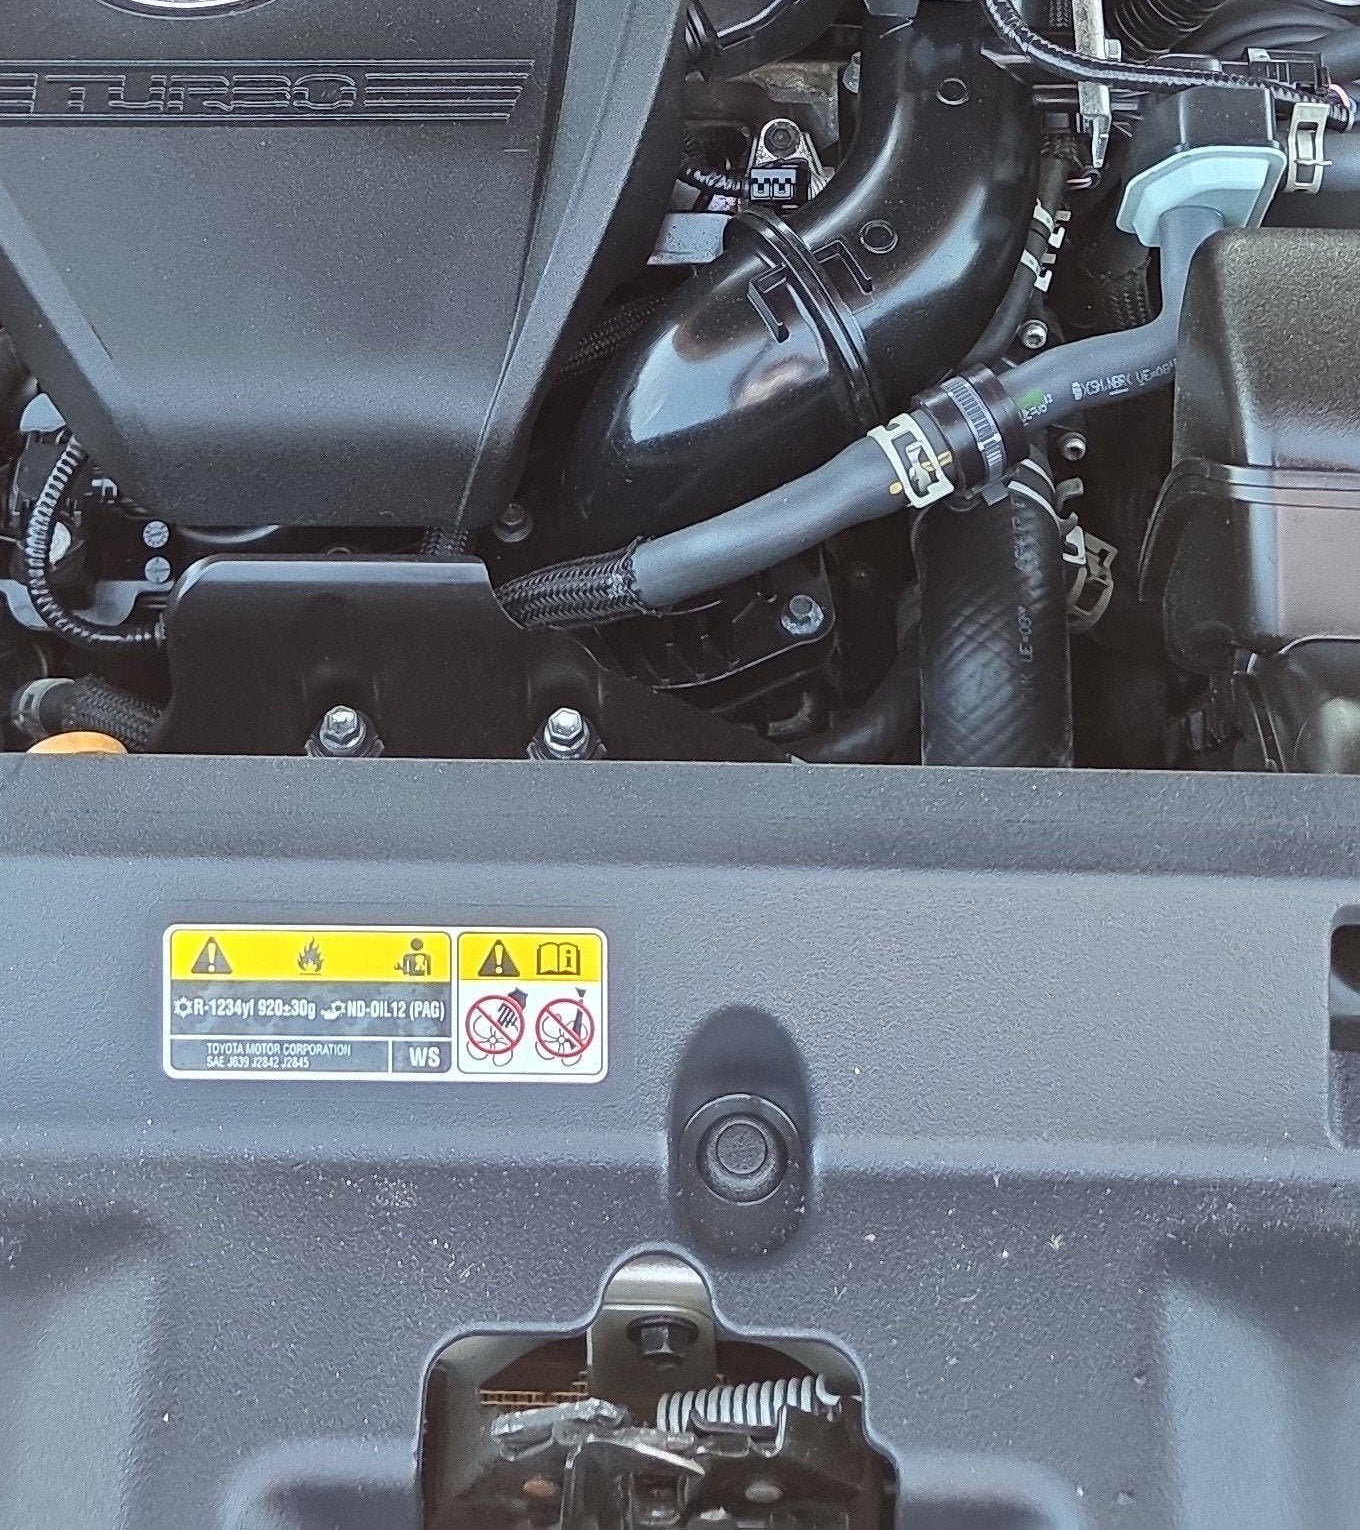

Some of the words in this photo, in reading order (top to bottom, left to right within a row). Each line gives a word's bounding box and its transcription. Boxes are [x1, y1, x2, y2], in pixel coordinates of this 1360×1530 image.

[45, 74, 356, 110] TURBO
[257, 999, 316, 1020] 920±30g
[347, 1000, 406, 1018] ND-OIL12
[409, 1000, 444, 1021] (PAG)
[206, 1042, 243, 1055] TOYOTA
[245, 1043, 280, 1056] MOTOR
[282, 1043, 351, 1056] CORPORATION
[409, 1046, 440, 1068] WS
[206, 1056, 225, 1068] SAE
[227, 1056, 249, 1068] J639
[251, 1056, 279, 1069] J2842
[281, 1057, 310, 1069] J2845
